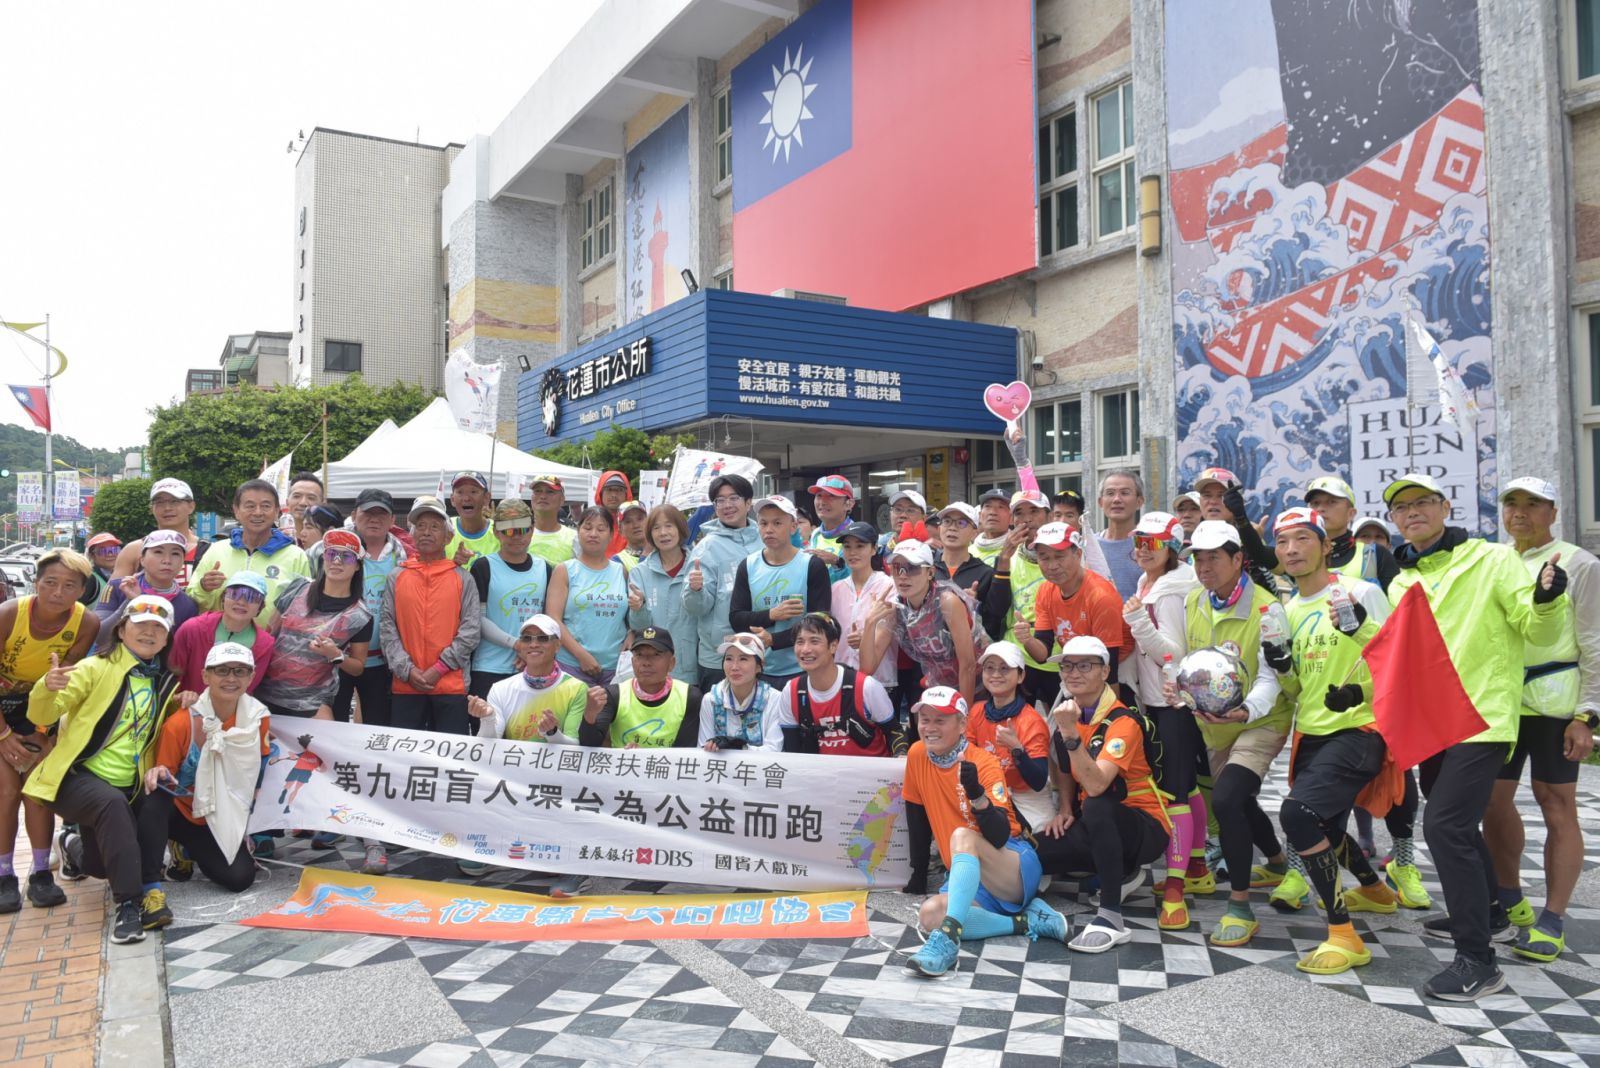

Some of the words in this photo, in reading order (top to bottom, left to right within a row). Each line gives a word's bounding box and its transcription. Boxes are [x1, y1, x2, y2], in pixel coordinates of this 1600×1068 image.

[566, 337, 650, 401] 花蓮市公所
[601, 405, 615, 421] City
[616, 399, 637, 414] Office
[739, 394, 830, 409] www.hualien.gov.tw
[1360, 431, 1464, 461] LIEN
[332, 761, 824, 843] 第九屆盲人環台為公益而跑
[466, 833, 488, 842] UNITE
[473, 841, 488, 849] FOR
[529, 843, 561, 853] TAIPEI
[474, 848, 496, 856] GOOD
[578, 845, 635, 864] 星展銀行
[654, 849, 693, 867] DBS
[715, 853, 809, 877] 國賓大戲院
